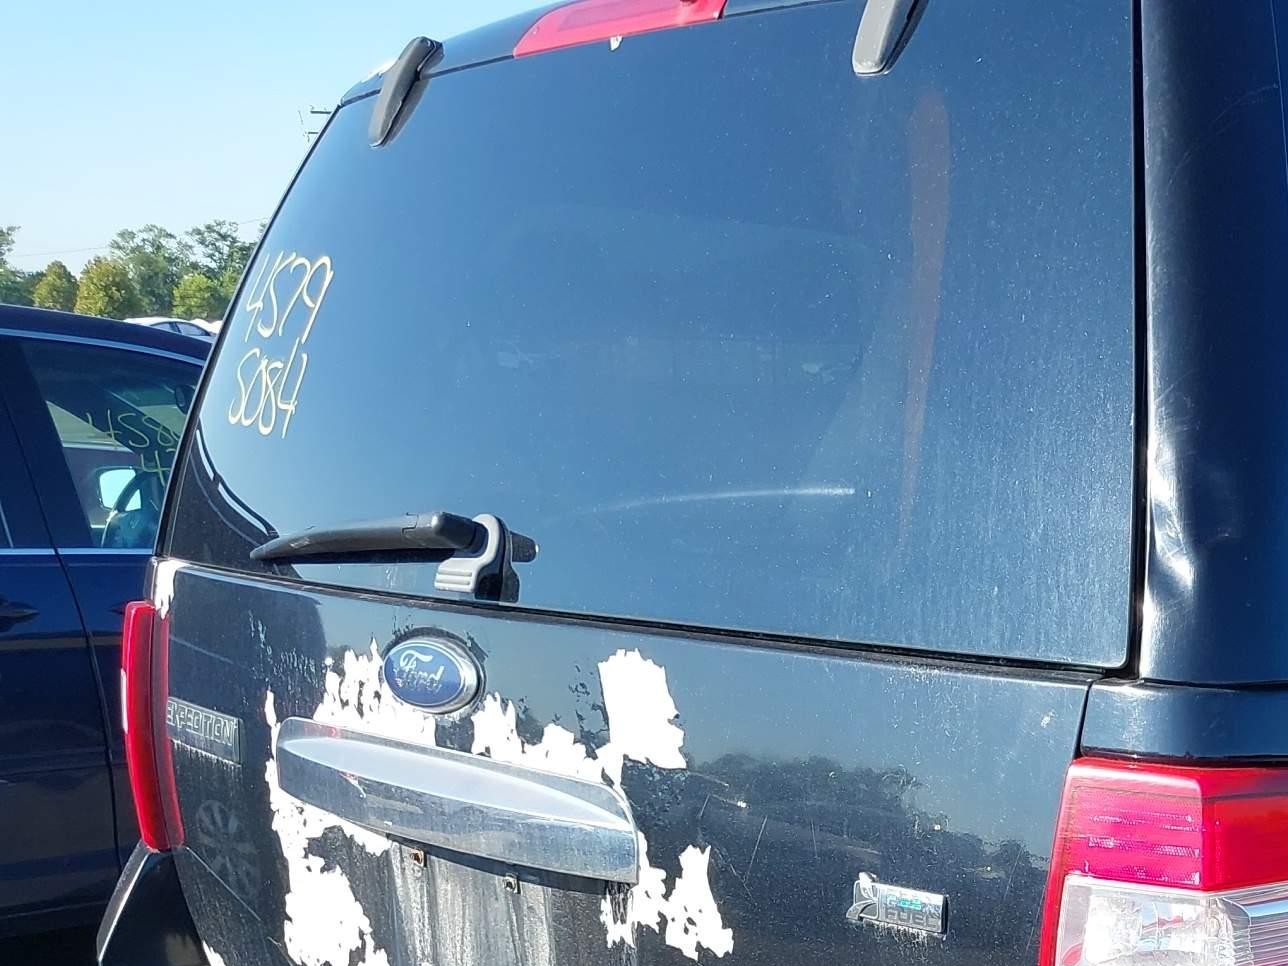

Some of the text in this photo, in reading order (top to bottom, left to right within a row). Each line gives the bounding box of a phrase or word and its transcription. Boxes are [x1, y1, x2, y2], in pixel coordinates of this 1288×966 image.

[244, 251, 335, 345] 4579
[84, 409, 180, 450] 458
[392, 649, 445, 692] Ford
